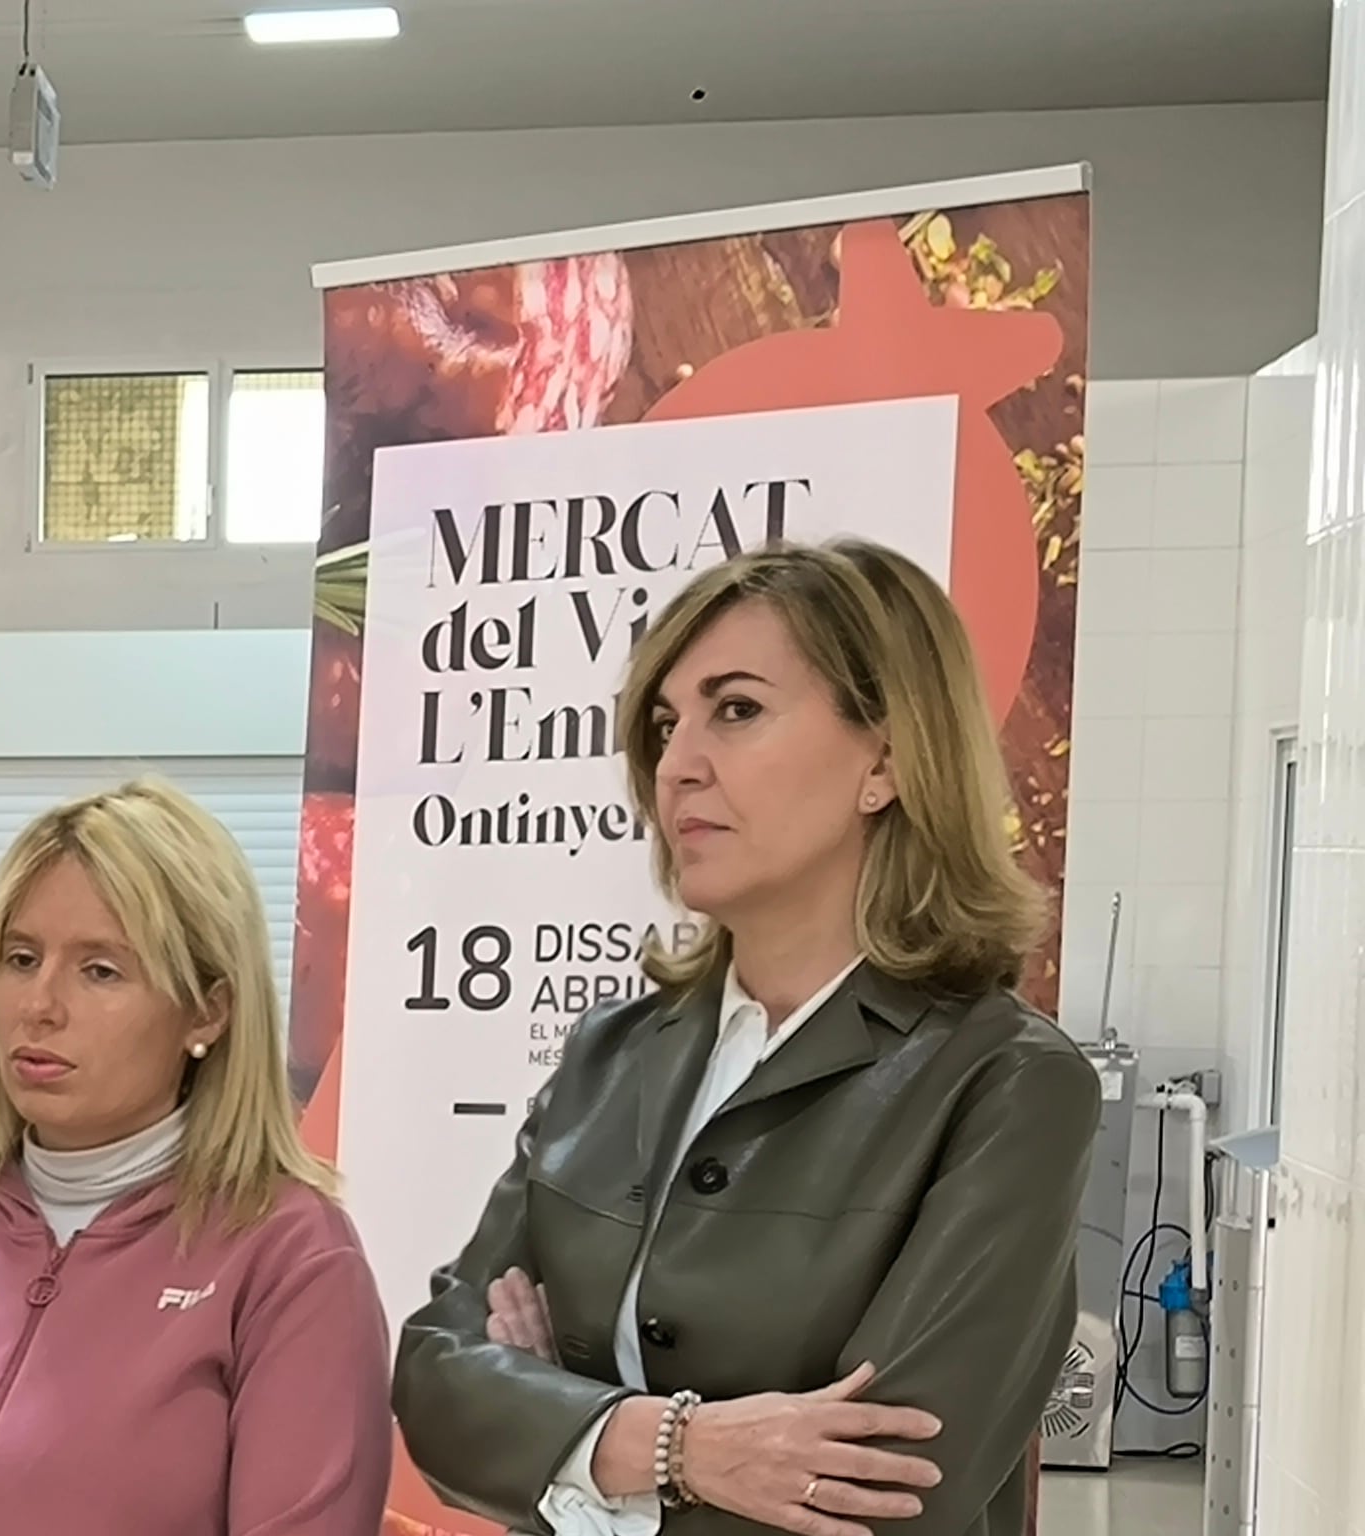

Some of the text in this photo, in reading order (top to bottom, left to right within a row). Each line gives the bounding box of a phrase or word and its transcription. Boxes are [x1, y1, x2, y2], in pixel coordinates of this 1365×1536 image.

[425, 479, 811, 588] MERCAT
[422, 596, 537, 673] del
[404, 925, 513, 1012] 18
[530, 1022, 548, 1040] EL
